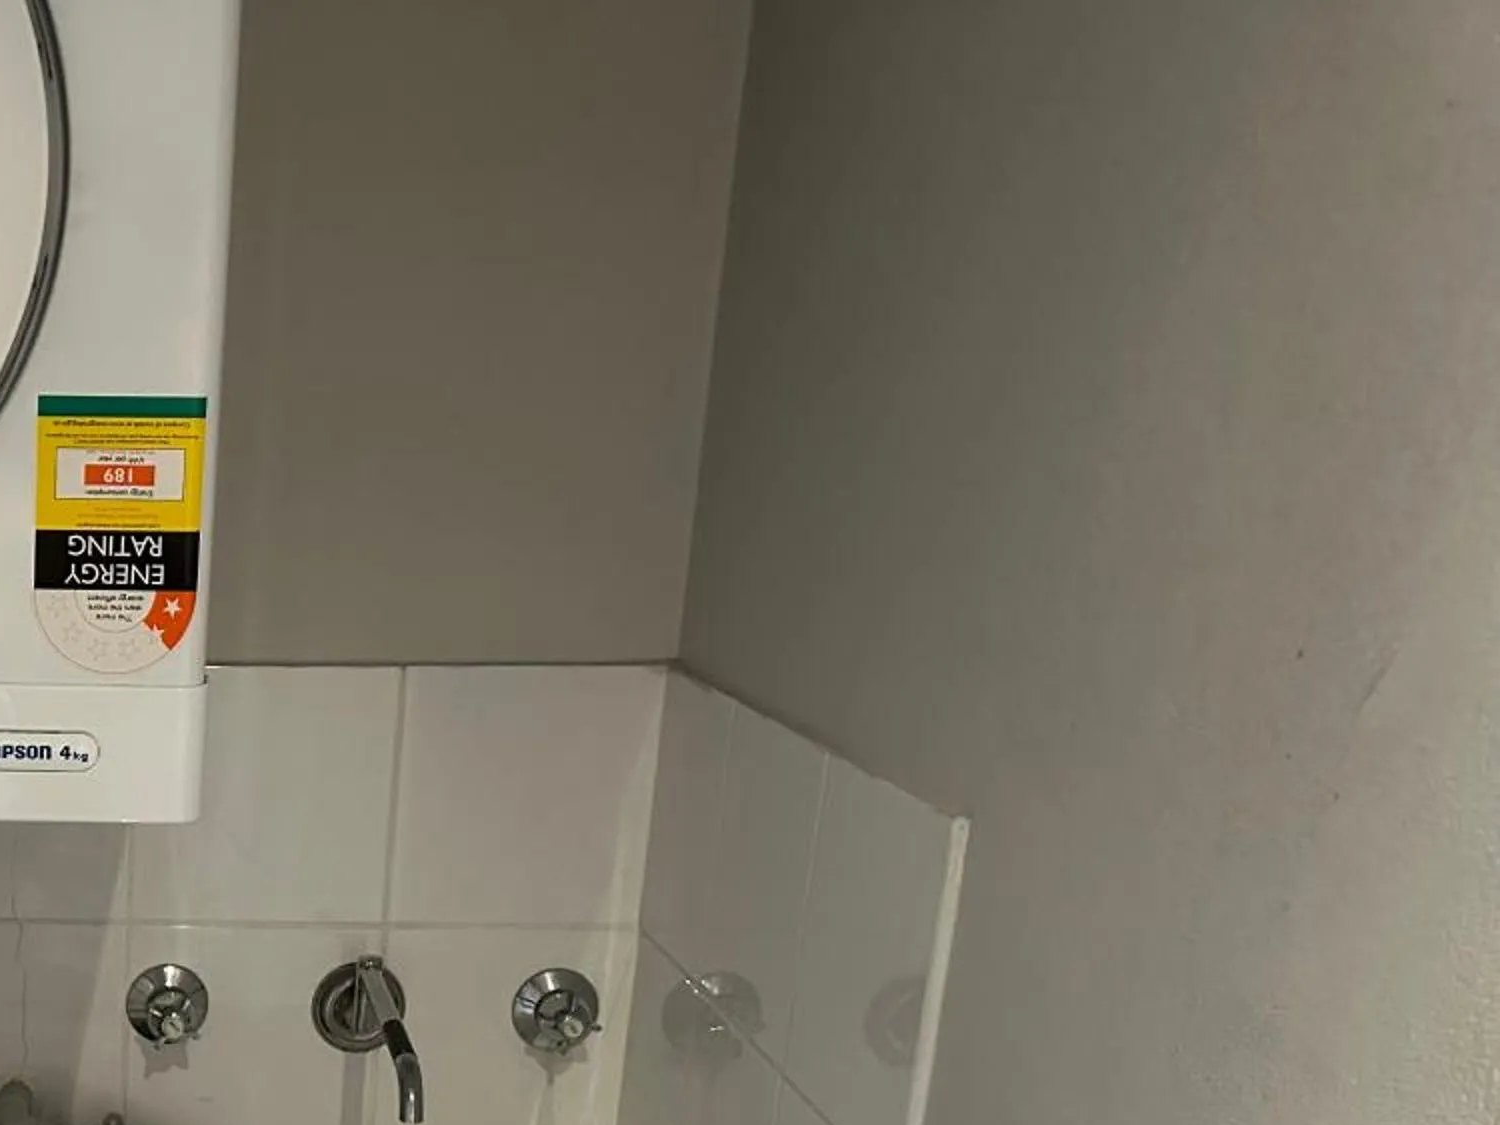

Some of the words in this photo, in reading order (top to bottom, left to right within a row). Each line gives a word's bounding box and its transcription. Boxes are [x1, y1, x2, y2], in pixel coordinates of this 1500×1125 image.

[103, 467, 133, 484] 189
[67, 534, 163, 557] RATING
[64, 563, 165, 585] ENERGY
